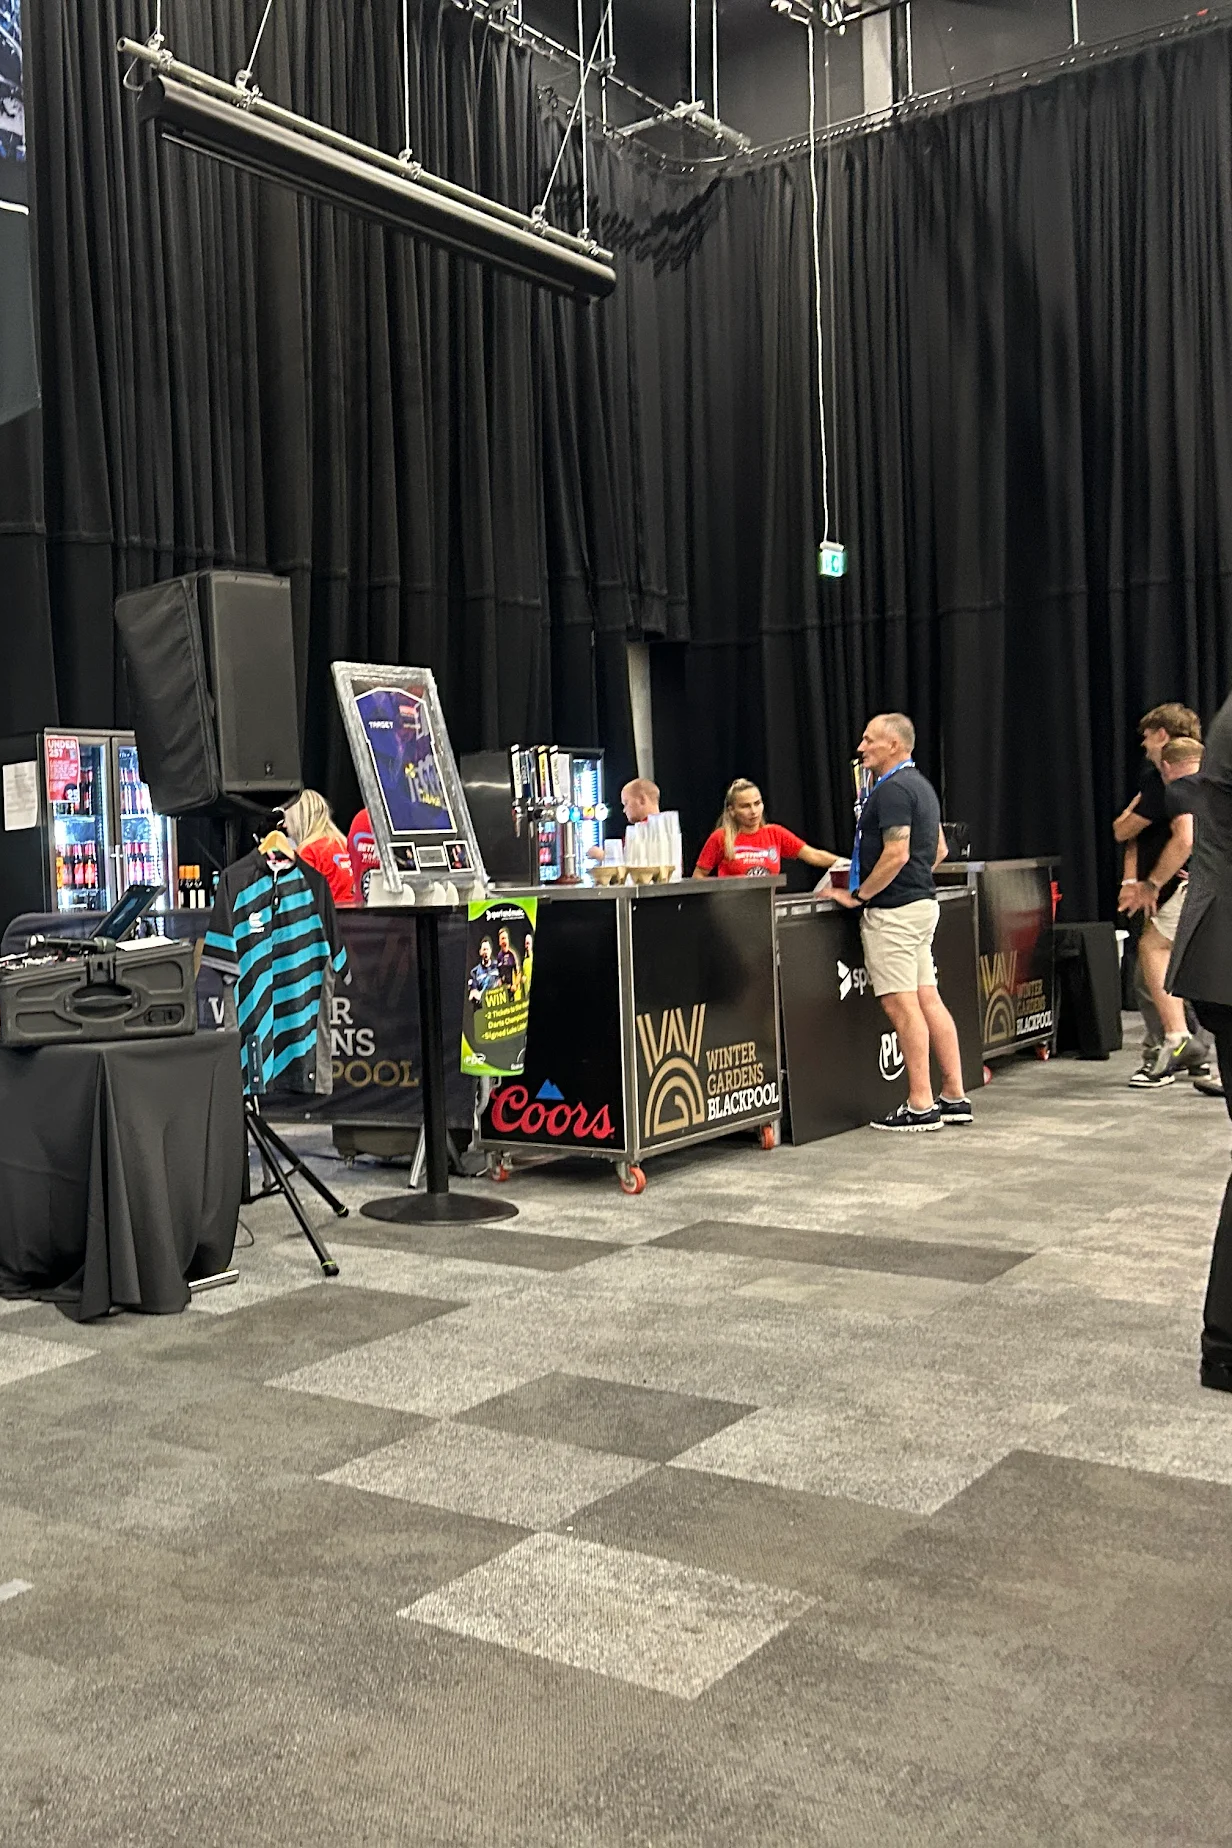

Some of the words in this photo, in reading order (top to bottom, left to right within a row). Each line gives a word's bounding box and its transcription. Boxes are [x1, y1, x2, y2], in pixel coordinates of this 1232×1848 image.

[48, 740, 76, 749] UNDER
[485, 991, 507, 1008] WIN
[1016, 1010, 1053, 1035] BLACKPOOL
[706, 1041, 757, 1071] WINTER
[881, 1032, 904, 1069] PD
[707, 1063, 764, 1097] GARDENS
[491, 1085, 615, 1140] Coors
[707, 1082, 779, 1121] BLACKPOOL
